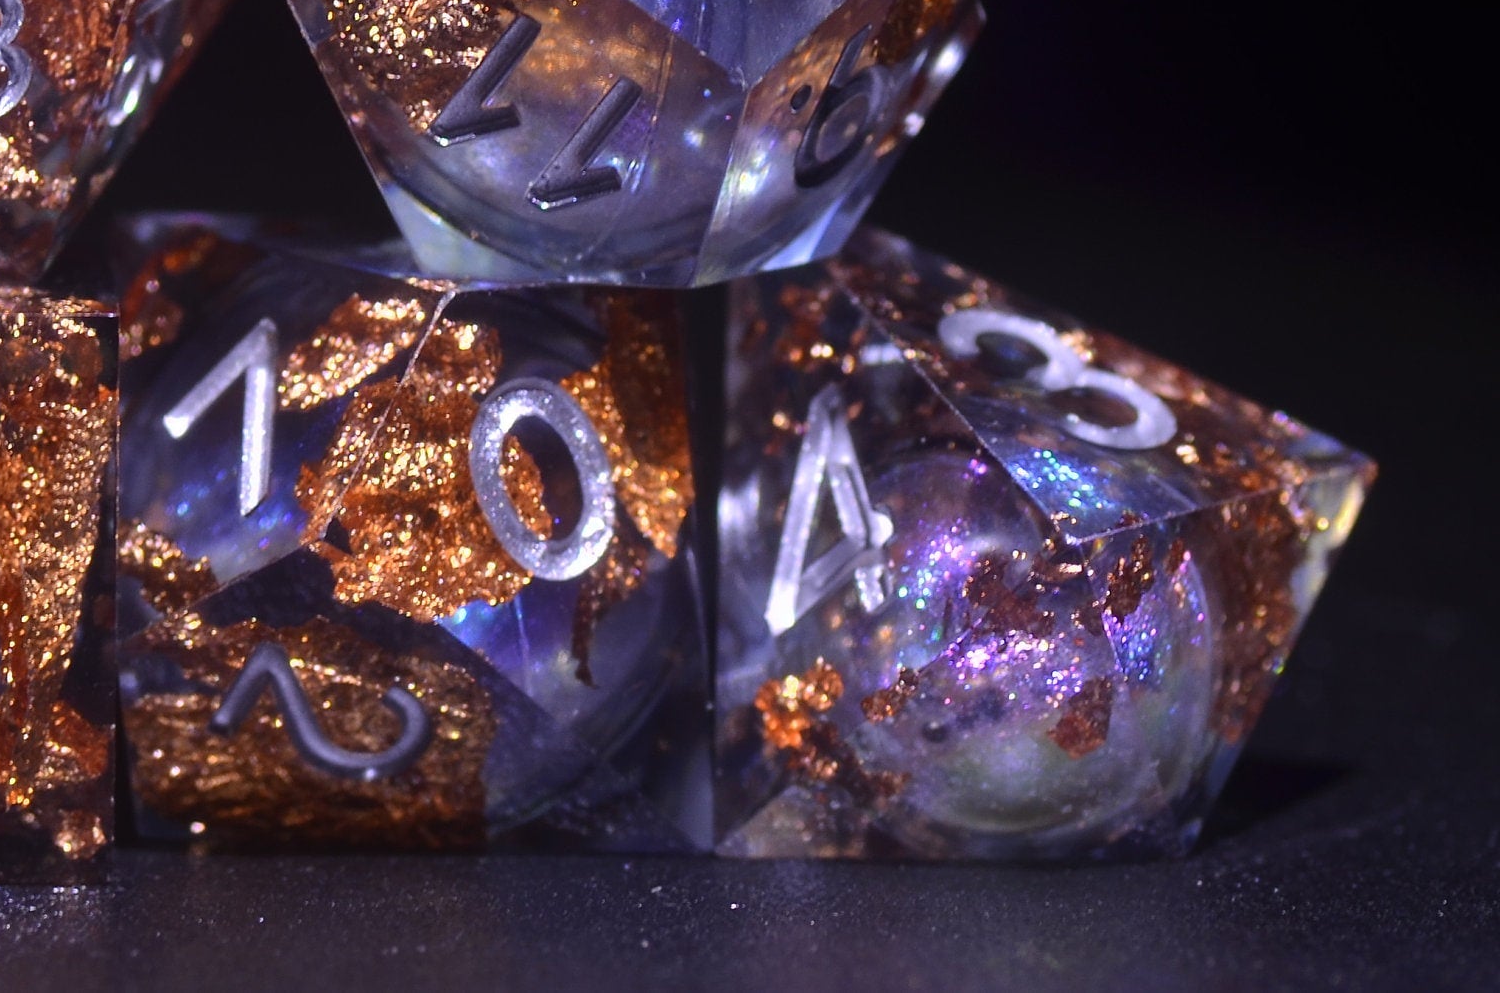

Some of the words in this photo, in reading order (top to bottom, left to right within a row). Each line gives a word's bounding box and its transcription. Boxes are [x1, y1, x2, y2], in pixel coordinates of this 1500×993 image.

[937, 309, 1178, 450] 3
[763, 382, 897, 638] 4
[208, 642, 432, 782] 2
